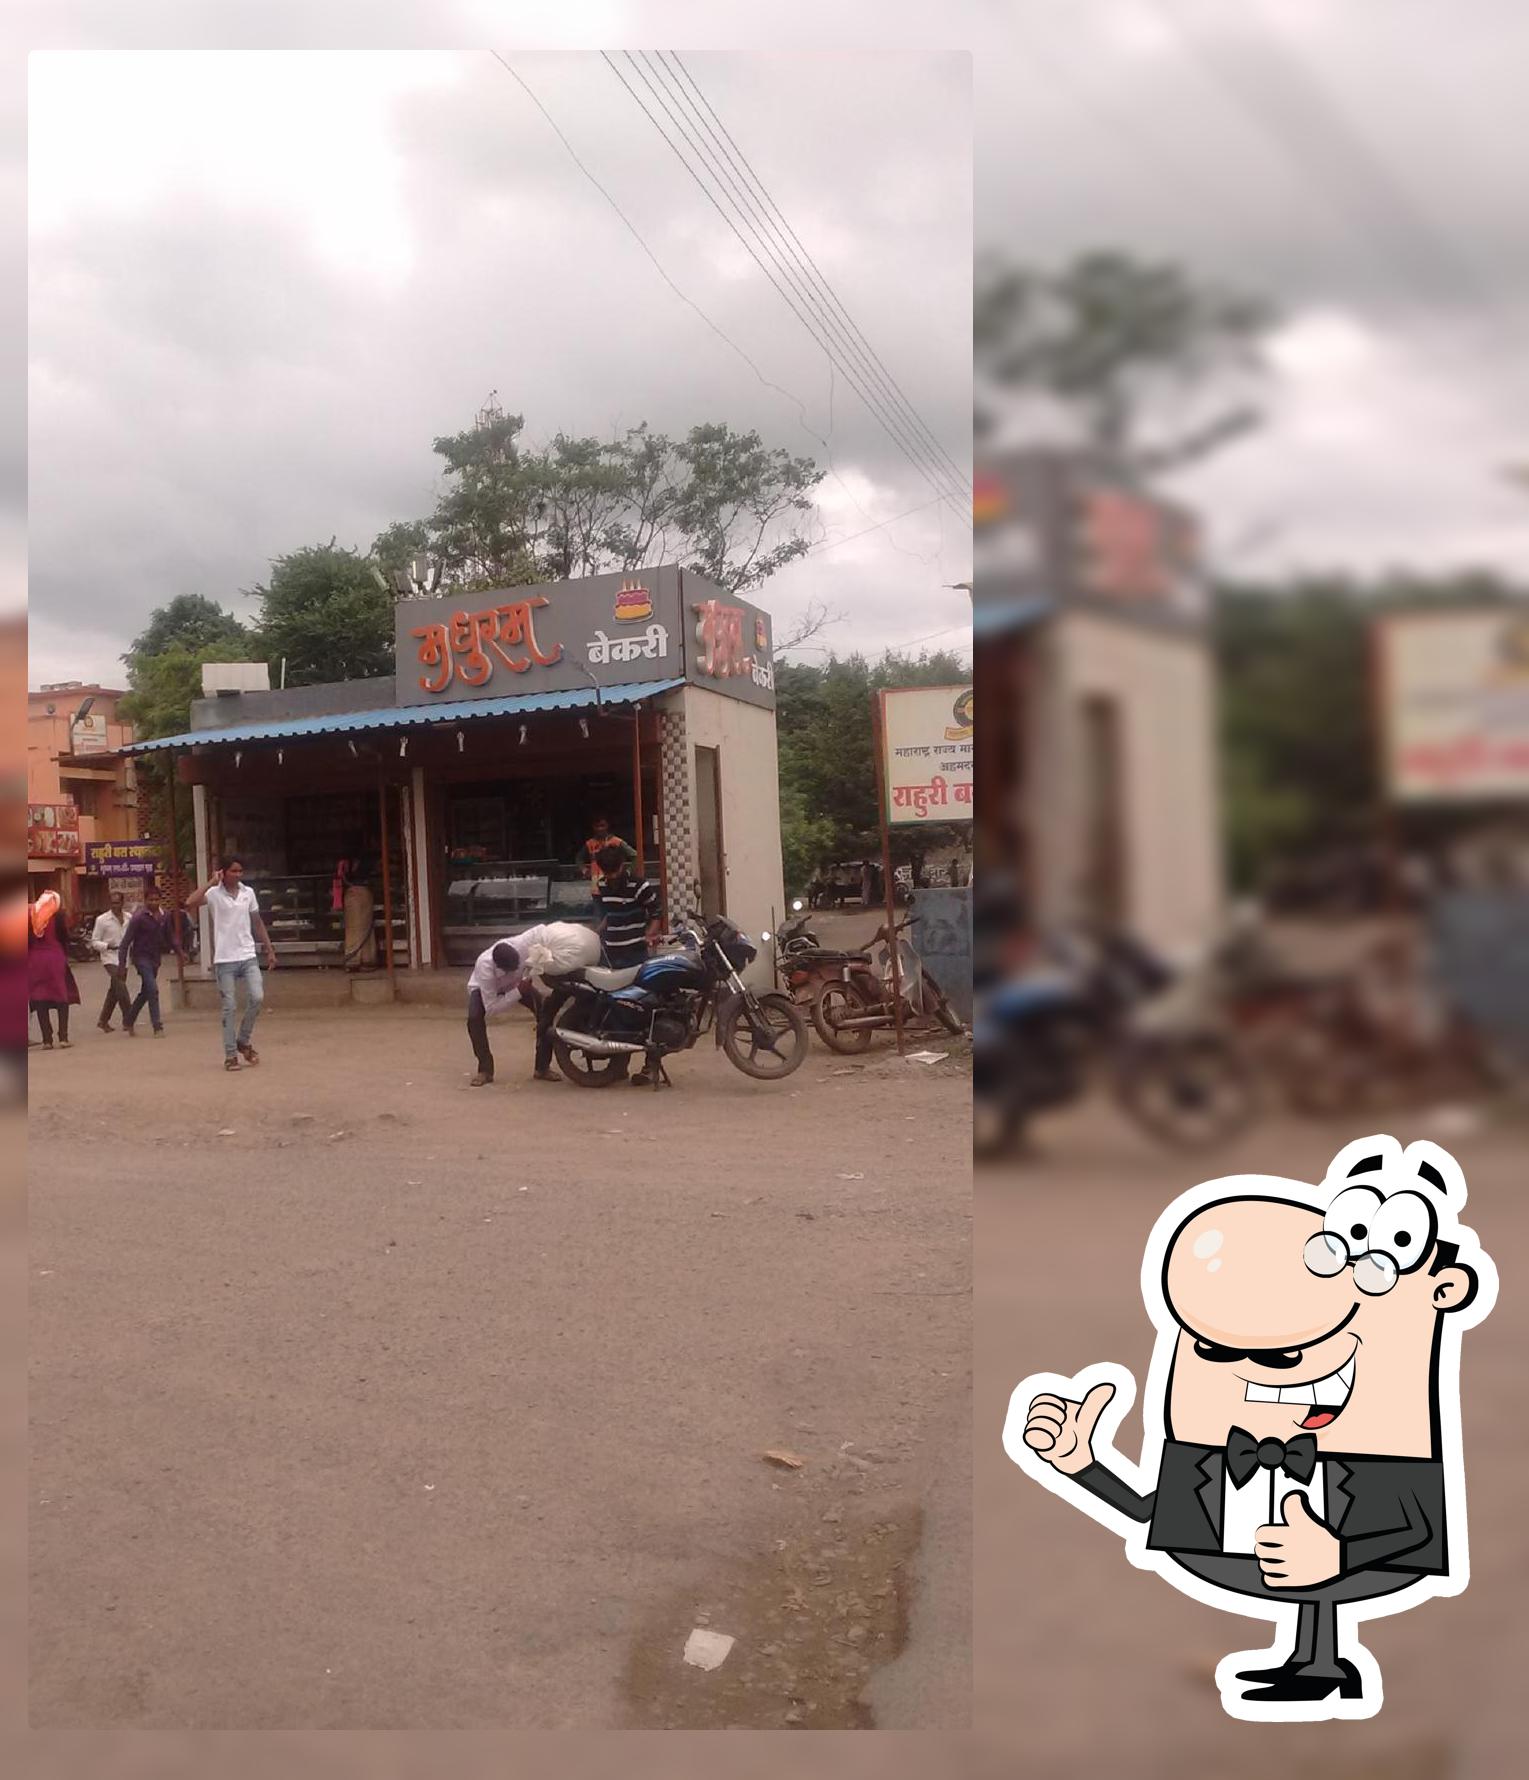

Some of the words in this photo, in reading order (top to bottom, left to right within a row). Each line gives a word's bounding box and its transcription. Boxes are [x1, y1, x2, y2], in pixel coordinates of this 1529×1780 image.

[408, 595, 567, 693] मधुरम
[586, 623, 670, 665] बेकरी
[752, 654, 774, 690] बेकरी
[895, 745, 930, 757] महाराष्ट्र
[933, 744, 956, 755] राज्य
[893, 776, 948, 817] राहुरी
[953, 783, 973, 804] ब
